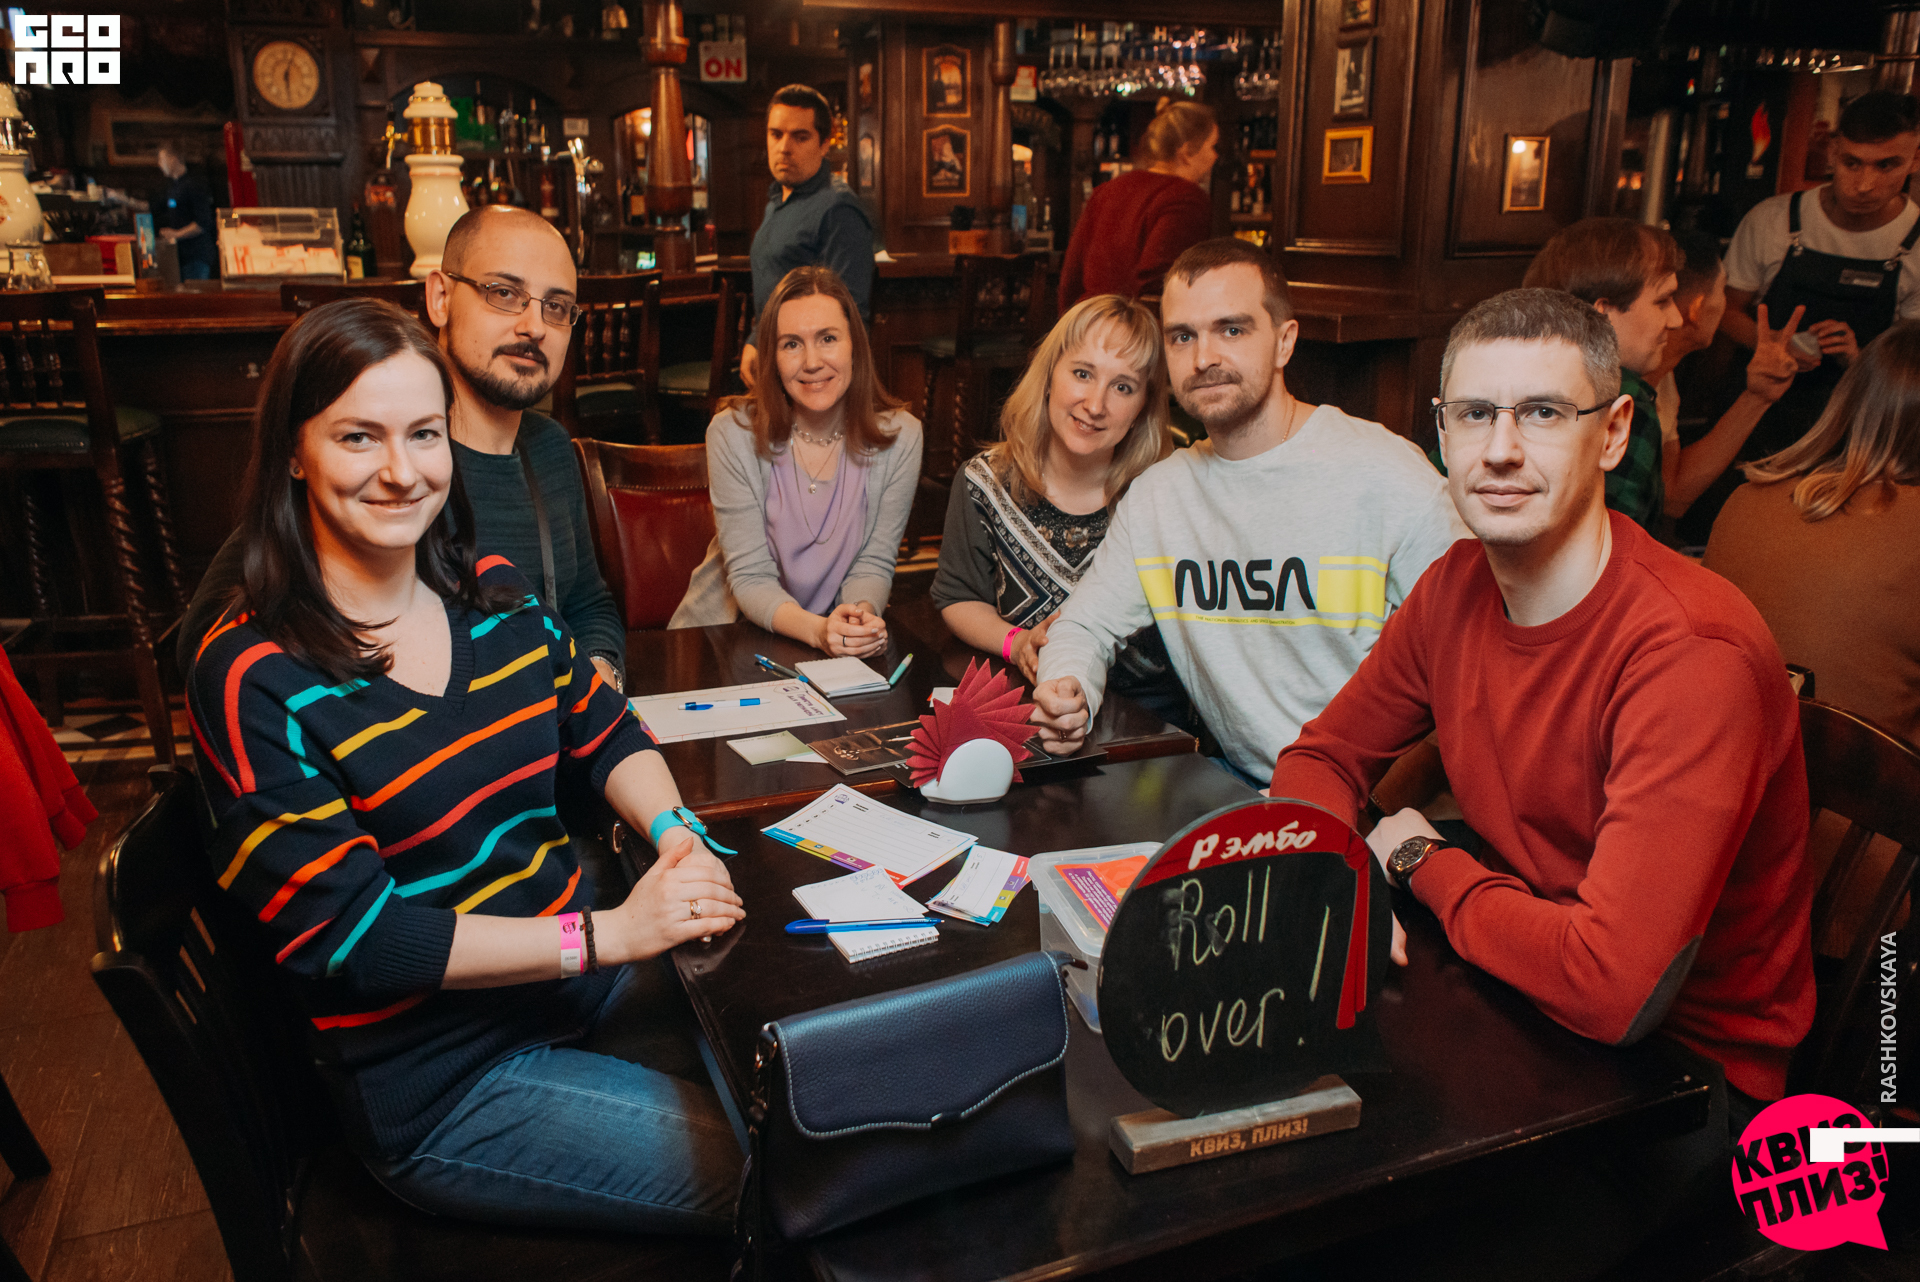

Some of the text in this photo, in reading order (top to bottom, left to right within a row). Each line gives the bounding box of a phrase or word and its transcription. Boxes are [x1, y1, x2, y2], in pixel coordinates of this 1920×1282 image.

[705, 57, 742, 78] ON
[1175, 557, 1316, 611] NASA
[1172, 865, 1271, 971] Roll
[1190, 1117, 1309, 1157] КВИЗ, ПЛИЗ!
